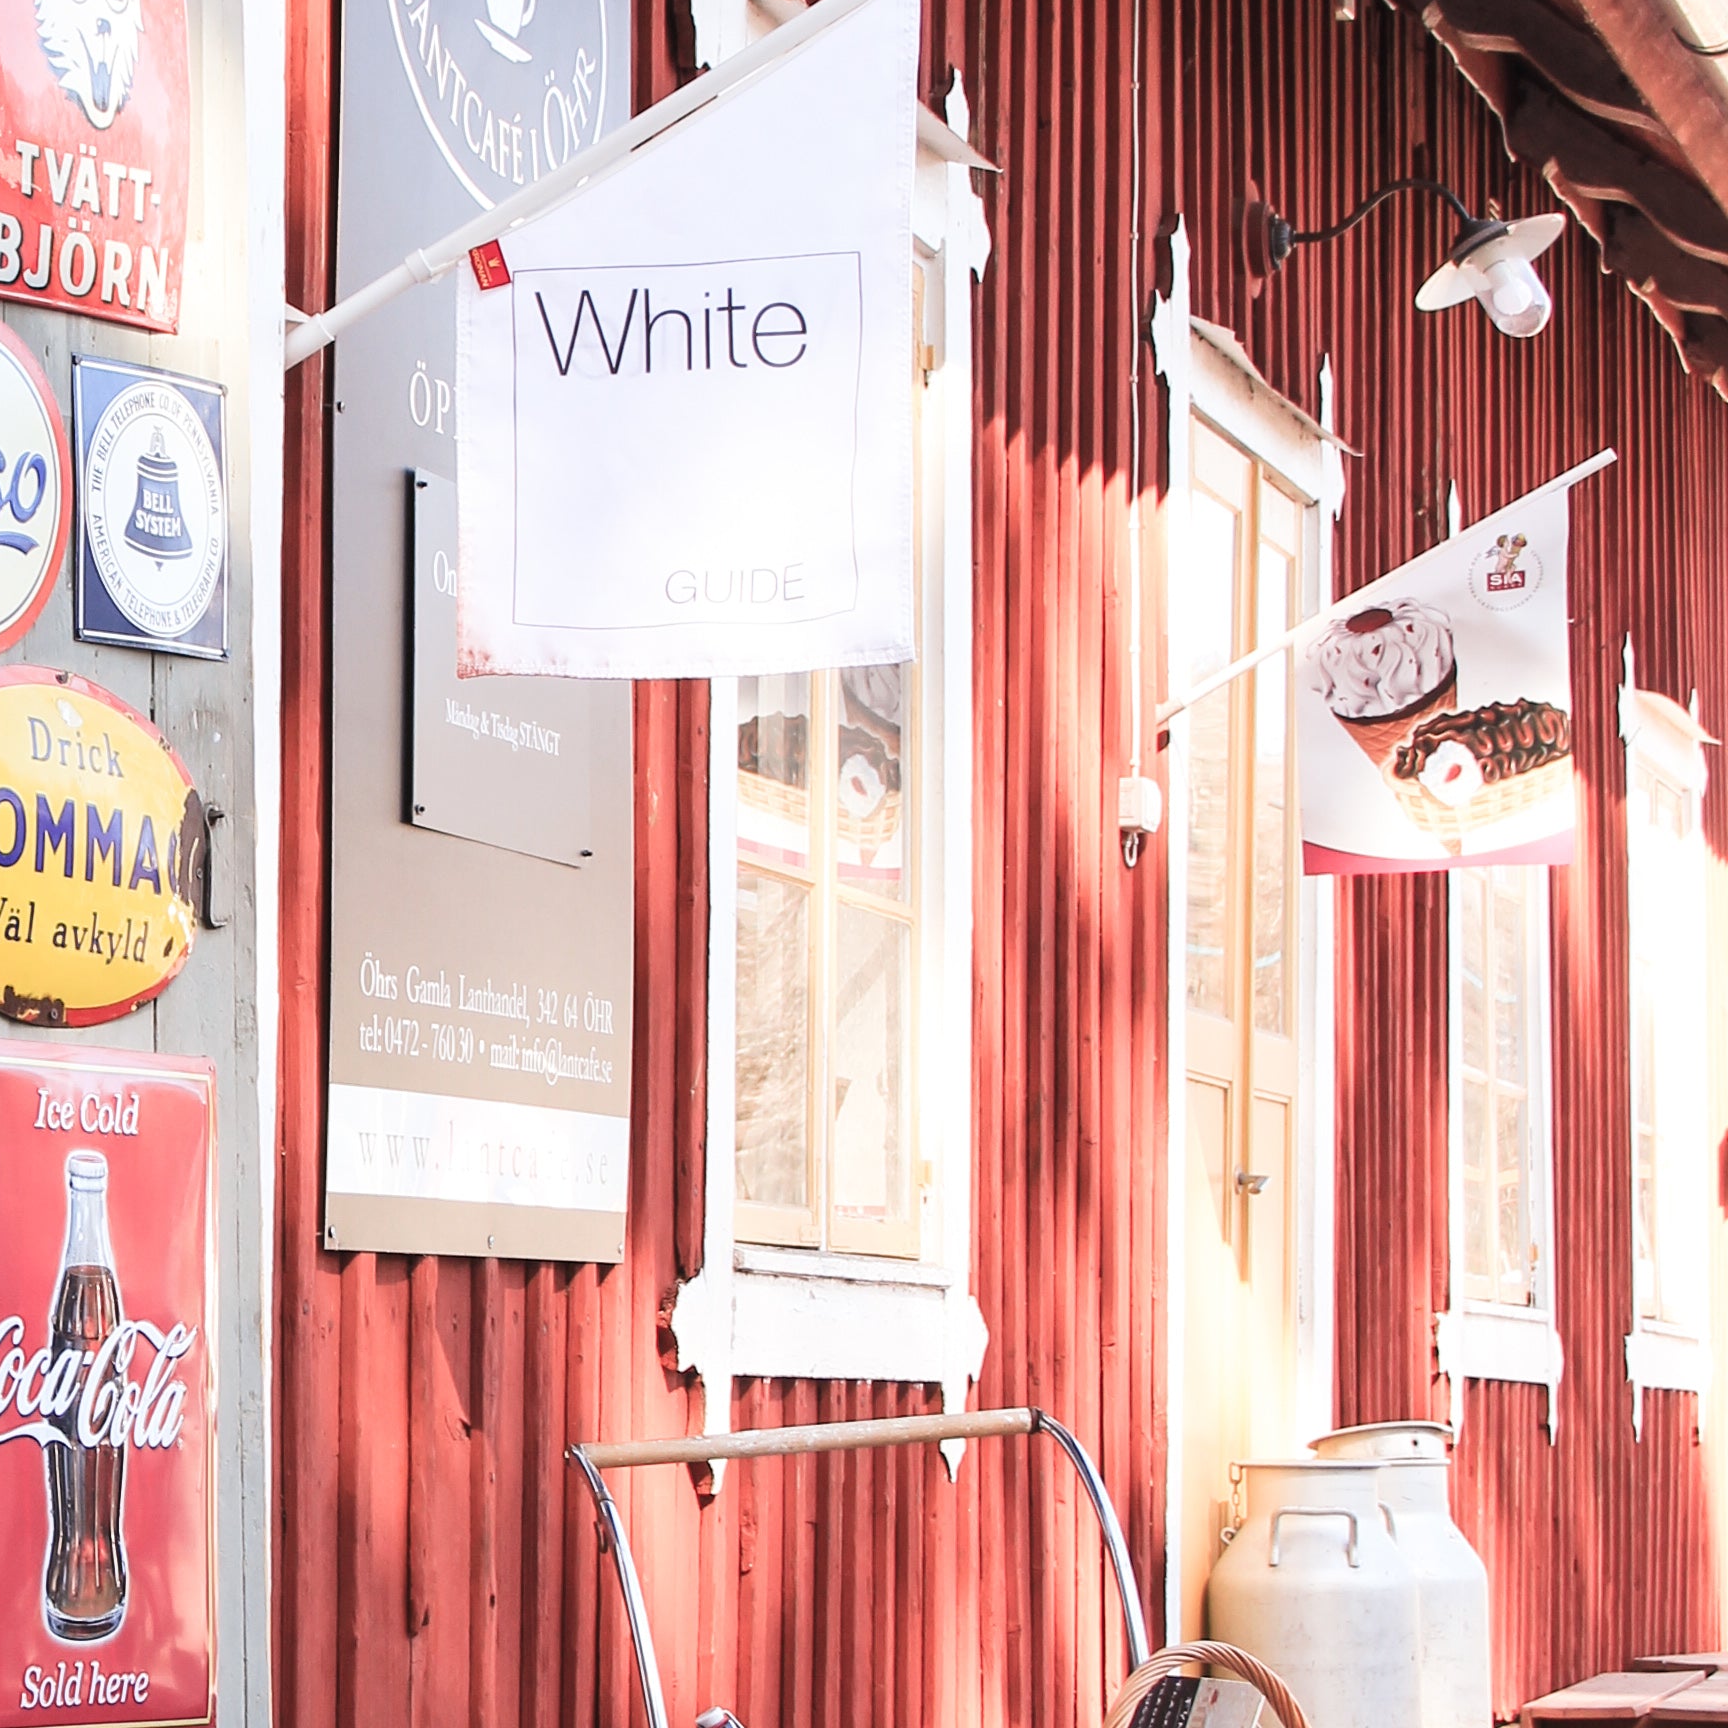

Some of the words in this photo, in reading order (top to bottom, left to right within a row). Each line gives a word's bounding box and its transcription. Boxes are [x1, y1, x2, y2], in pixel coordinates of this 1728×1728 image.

[543, 47, 596, 170] ÖHR
[15, 139, 161, 222] TVÄTT-
[535, 287, 808, 376] White
[111, 392, 155, 430] TELEPHONE
[96, 430, 115, 461] BELL
[183, 415, 220, 516] PENNSYLVANIA
[91, 466, 103, 492] THE
[142, 488, 174, 514] BELL
[134, 512, 182, 538] SYSTEM
[91, 514, 124, 595] AMERICAN
[123, 589, 173, 629] TELEPHONE
[173, 610, 181, 626] &
[181, 559, 216, 623] TELEGRAPH
[665, 562, 805, 605] GUIDE
[1490, 573, 1522, 586] SIA
[27, 716, 125, 779] Drick
[445, 698, 479, 740] Måndag
[480, 711, 489, 736] &
[490, 713, 518, 751] Tisdag
[520, 721, 560, 756] STÄNGT
[52, 911, 151, 965] avkyld
[360, 951, 398, 1001] Öhrs
[406, 965, 451, 1008] Gamla
[459, 974, 529, 1029] Lanthandel,
[536, 988, 558, 1025] 342
[564, 993, 578, 1028] 64
[584, 991, 614, 1035] ÖHR
[360, 1014, 381, 1053] tel:
[384, 1016, 419, 1056] 0472
[33, 1087, 75, 1134] Ice
[80, 1091, 141, 1137] Cold
[20, 1662, 84, 1711] Sold
[88, 1659, 149, 1705] here
